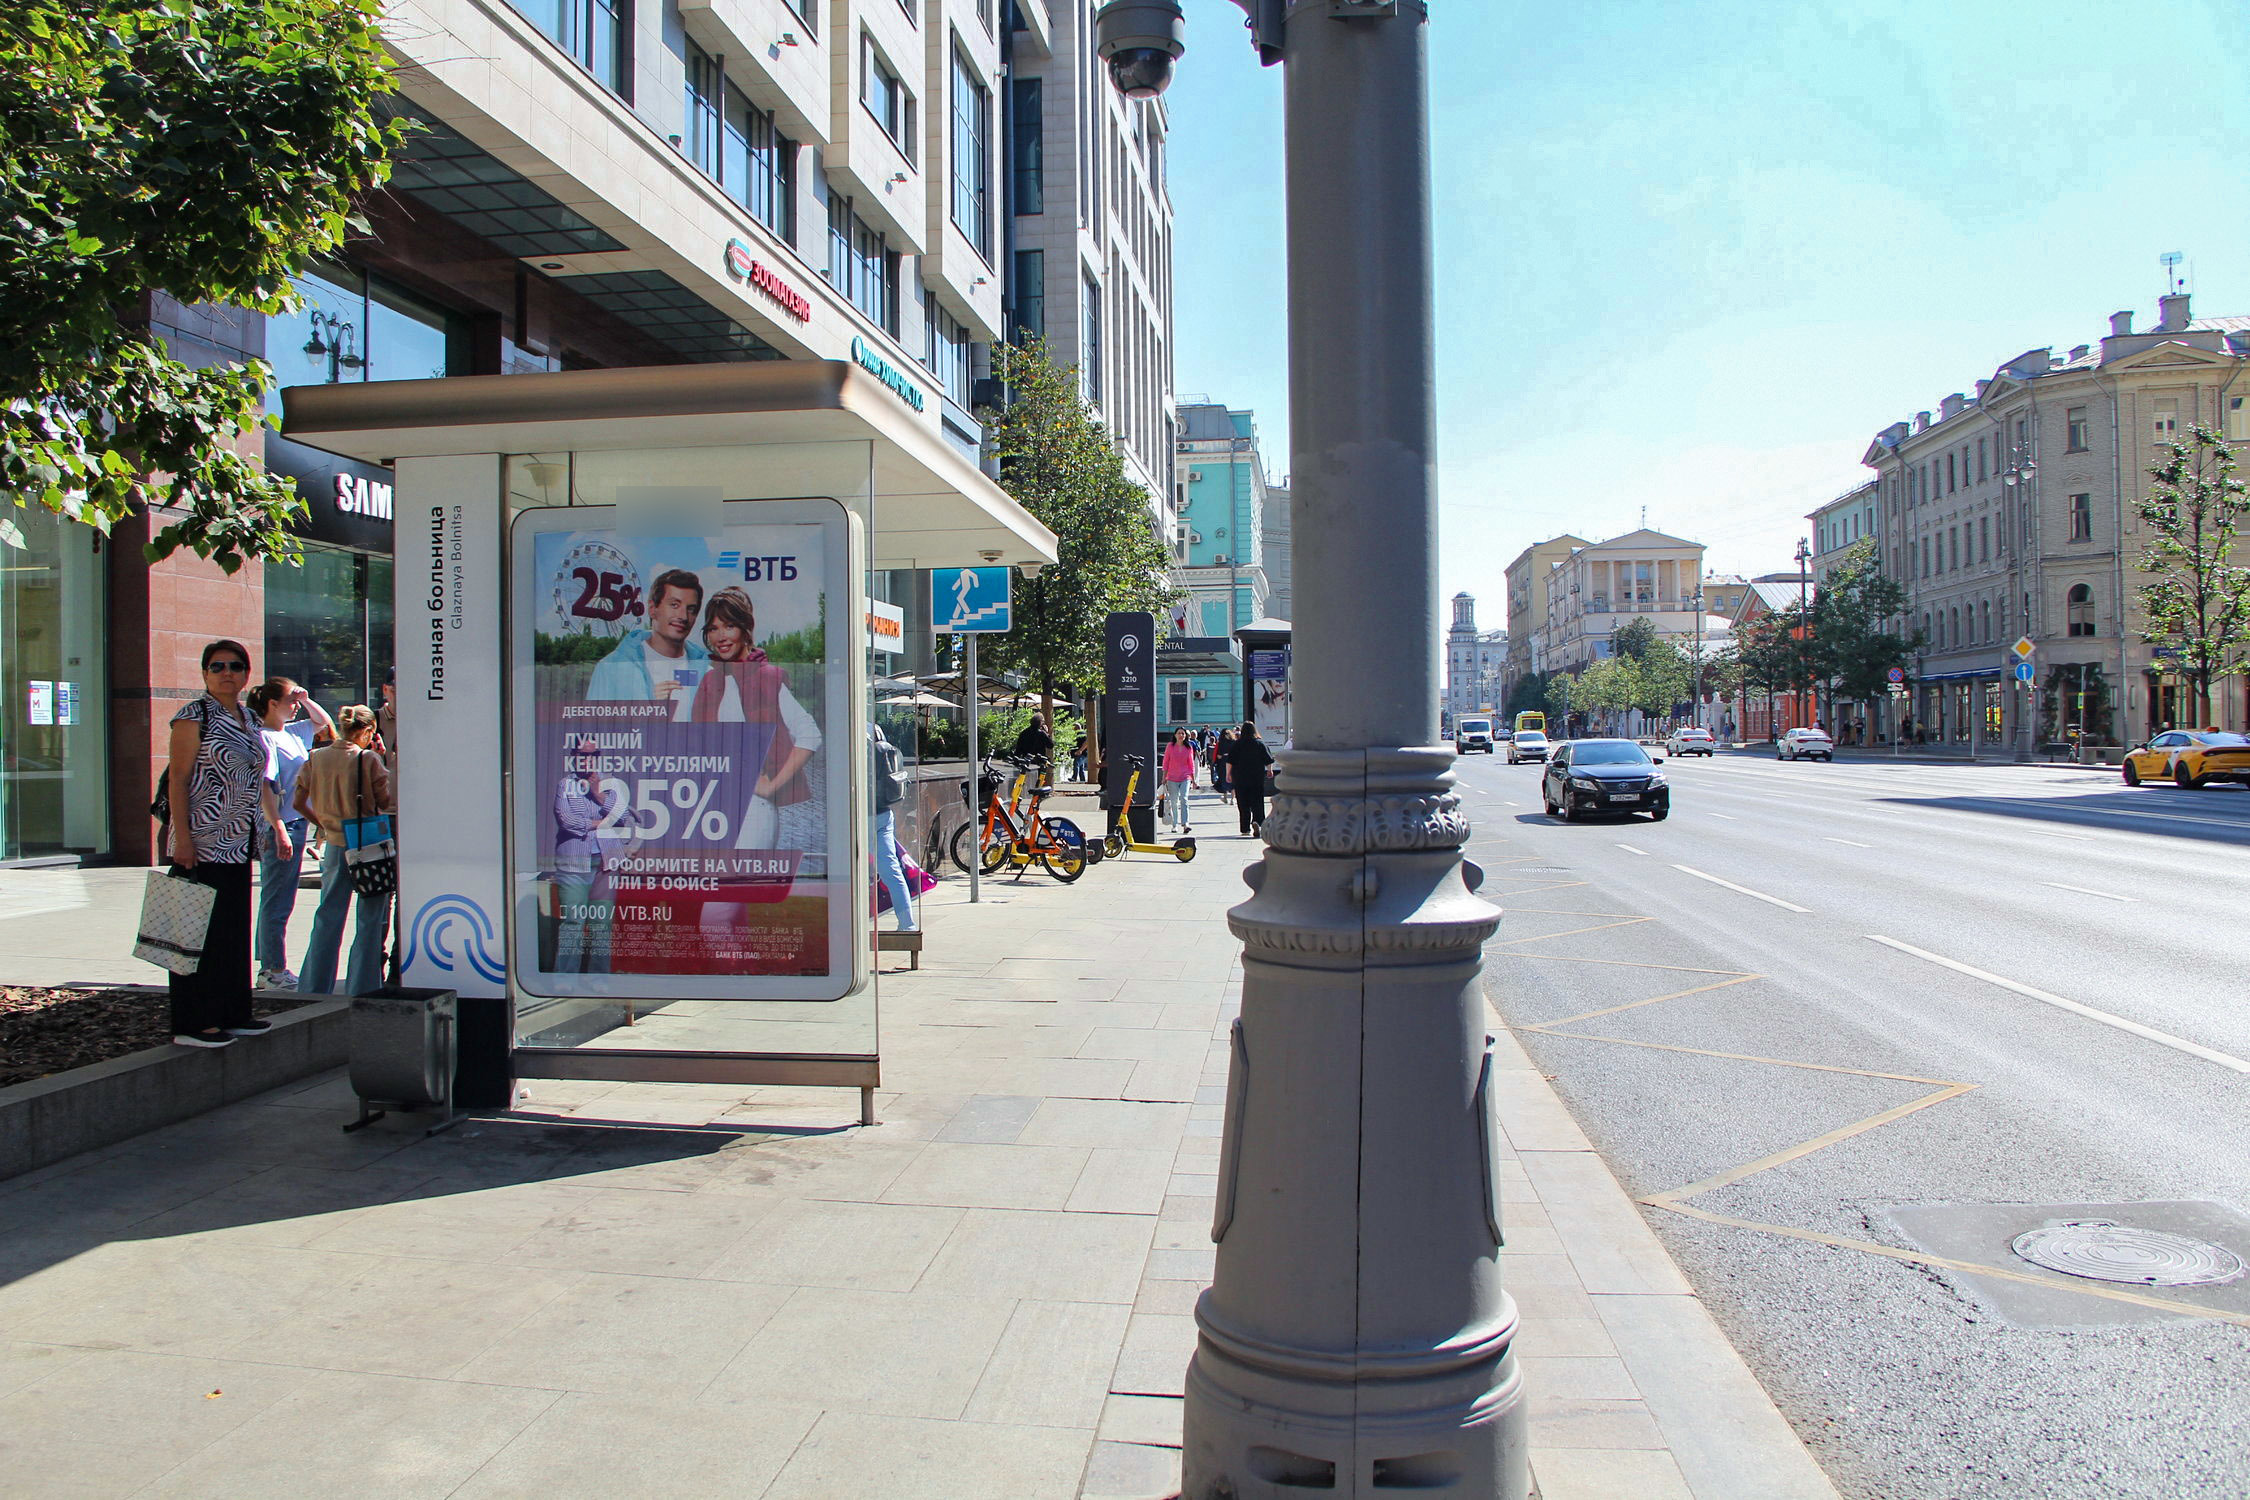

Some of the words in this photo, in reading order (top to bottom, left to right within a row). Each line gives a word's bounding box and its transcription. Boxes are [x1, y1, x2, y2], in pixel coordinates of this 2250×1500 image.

[752, 260, 811, 323] ЗООМАГАЗИН
[337, 472, 392, 520] SAM
[451, 504, 463, 561] Bolnitsa
[427, 506, 447, 611] больница
[744, 556, 798, 582] ВТБ
[451, 566, 465, 630] Glaznaya
[571, 566, 645, 622] 25%
[428, 617, 444, 700] Глазная
[562, 706, 627, 720] ДЕБЕТОВАЯ
[630, 706, 668, 718] КАРТА
[563, 728, 642, 751] ЛУЧШИЙ
[563, 755, 638, 774] КЕШБЭК
[642, 755, 730, 774] РУБЛЯМИ
[597, 778, 729, 841] 25%
[608, 857, 700, 874] ОФОРМИТЕ
[704, 859, 727, 874] НА
[732, 858, 790, 875] VTB.RU
[608, 876, 643, 891] ИЛИ
[647, 876, 657, 891] В
[662, 874, 719, 892] ОФИСЕ
[571, 905, 607, 920] 1000
[610, 905, 616, 919] /
[619, 906, 673, 921] VTB.RU
